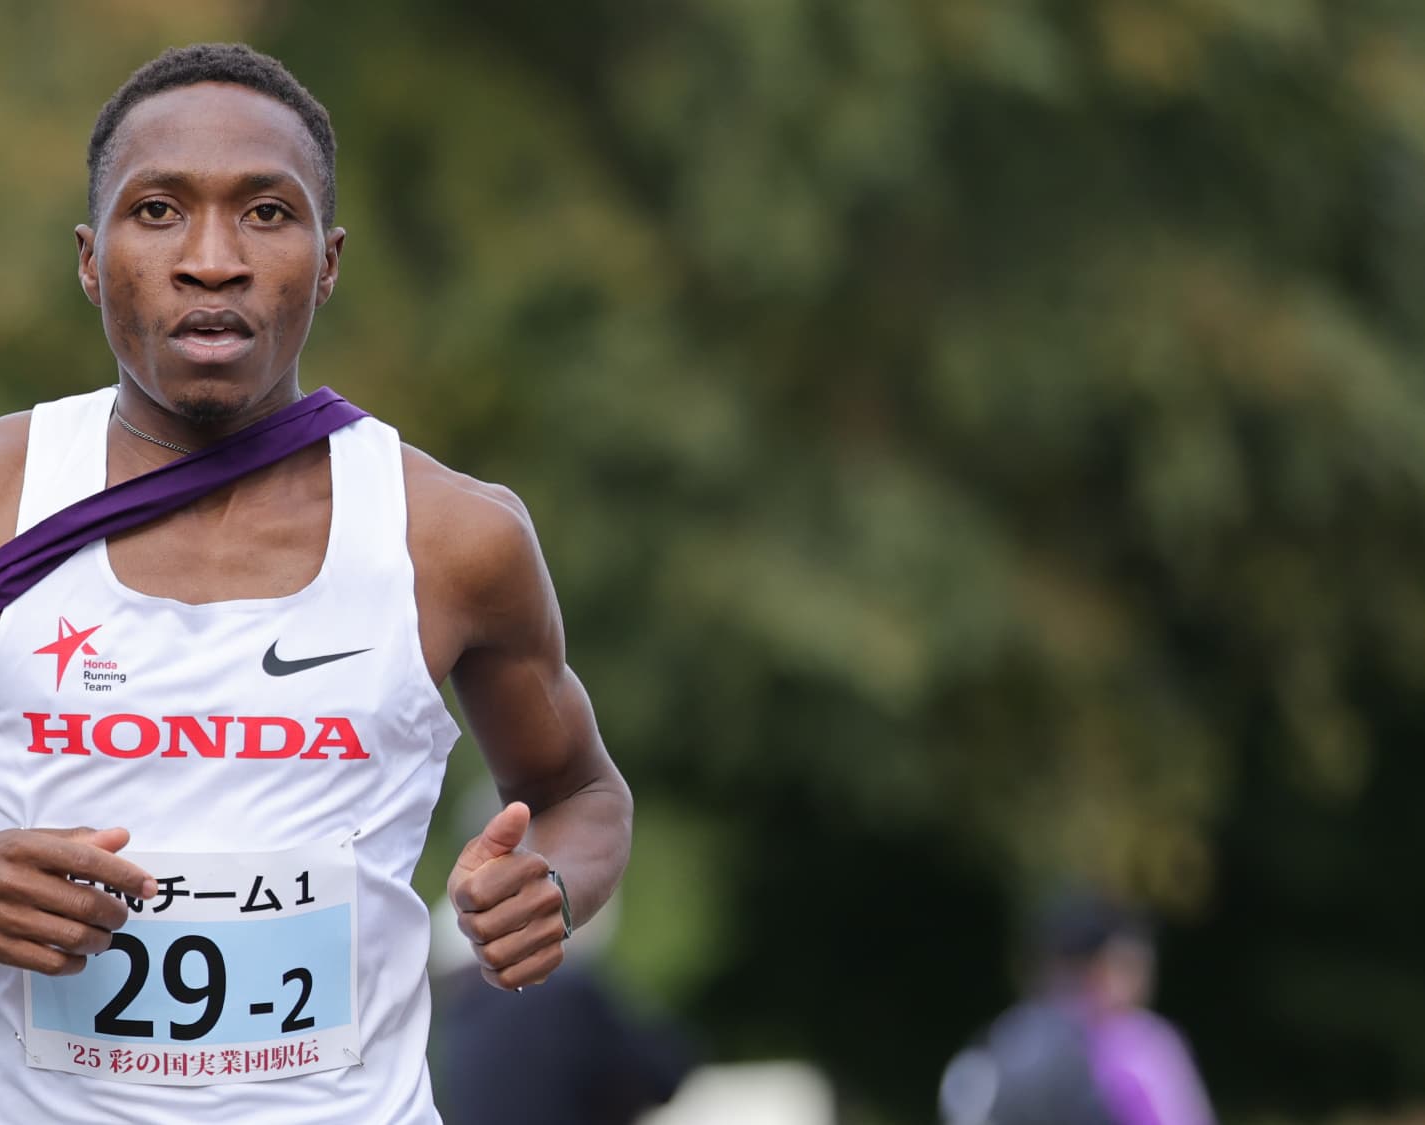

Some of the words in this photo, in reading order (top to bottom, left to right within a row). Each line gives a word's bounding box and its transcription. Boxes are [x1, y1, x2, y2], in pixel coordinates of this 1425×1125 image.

[83, 659, 118, 670] Honda
[83, 670, 127, 684] Running
[83, 681, 112, 692] Team
[22, 712, 371, 761] HONDA
[67, 1042, 101, 1068] '25
[109, 1039, 320, 1077] 彩の国実業団駅伝
